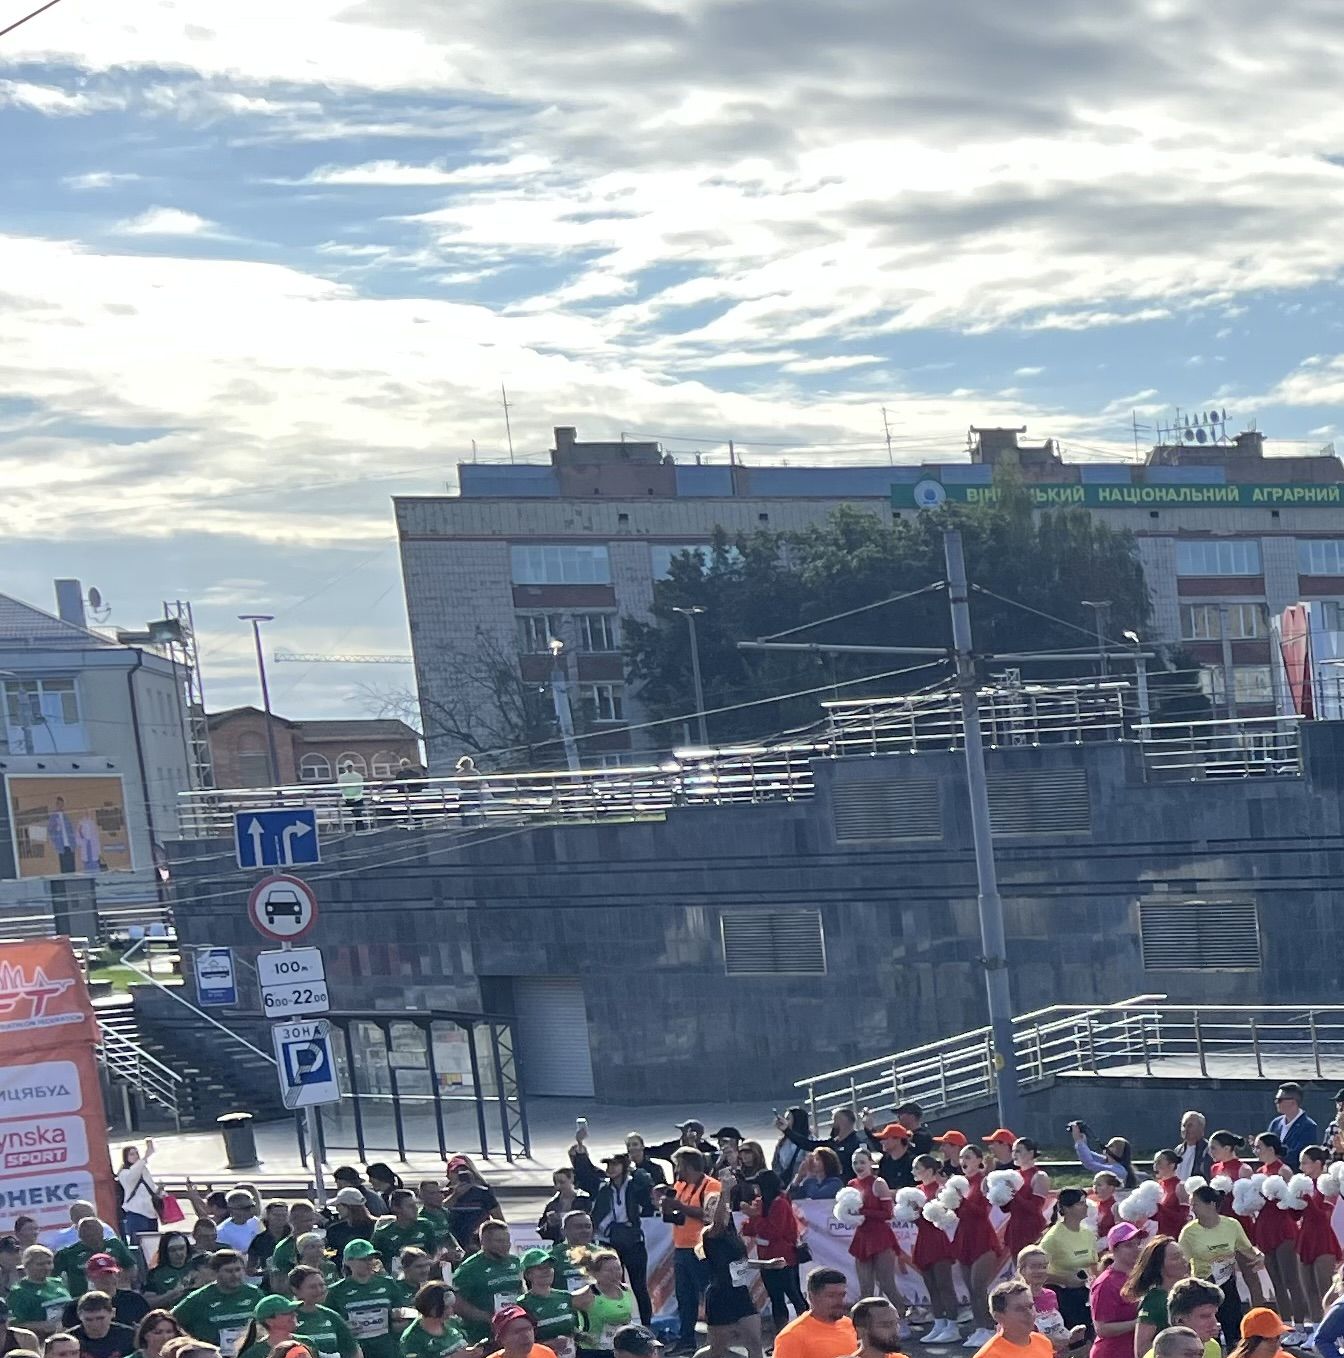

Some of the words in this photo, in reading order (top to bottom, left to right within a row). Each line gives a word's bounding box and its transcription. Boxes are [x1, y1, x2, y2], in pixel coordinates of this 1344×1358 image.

[966, 485, 1085, 502] ВІНЬКИЙ
[1098, 485, 1239, 505] НАЦІОНАЛЬНИЙ
[1252, 485, 1340, 501] АГРАРНИЙ
[275, 961, 300, 974] 100
[282, 1025, 322, 1039] ЗОНА
[7, 1150, 66, 1167] SPORT
